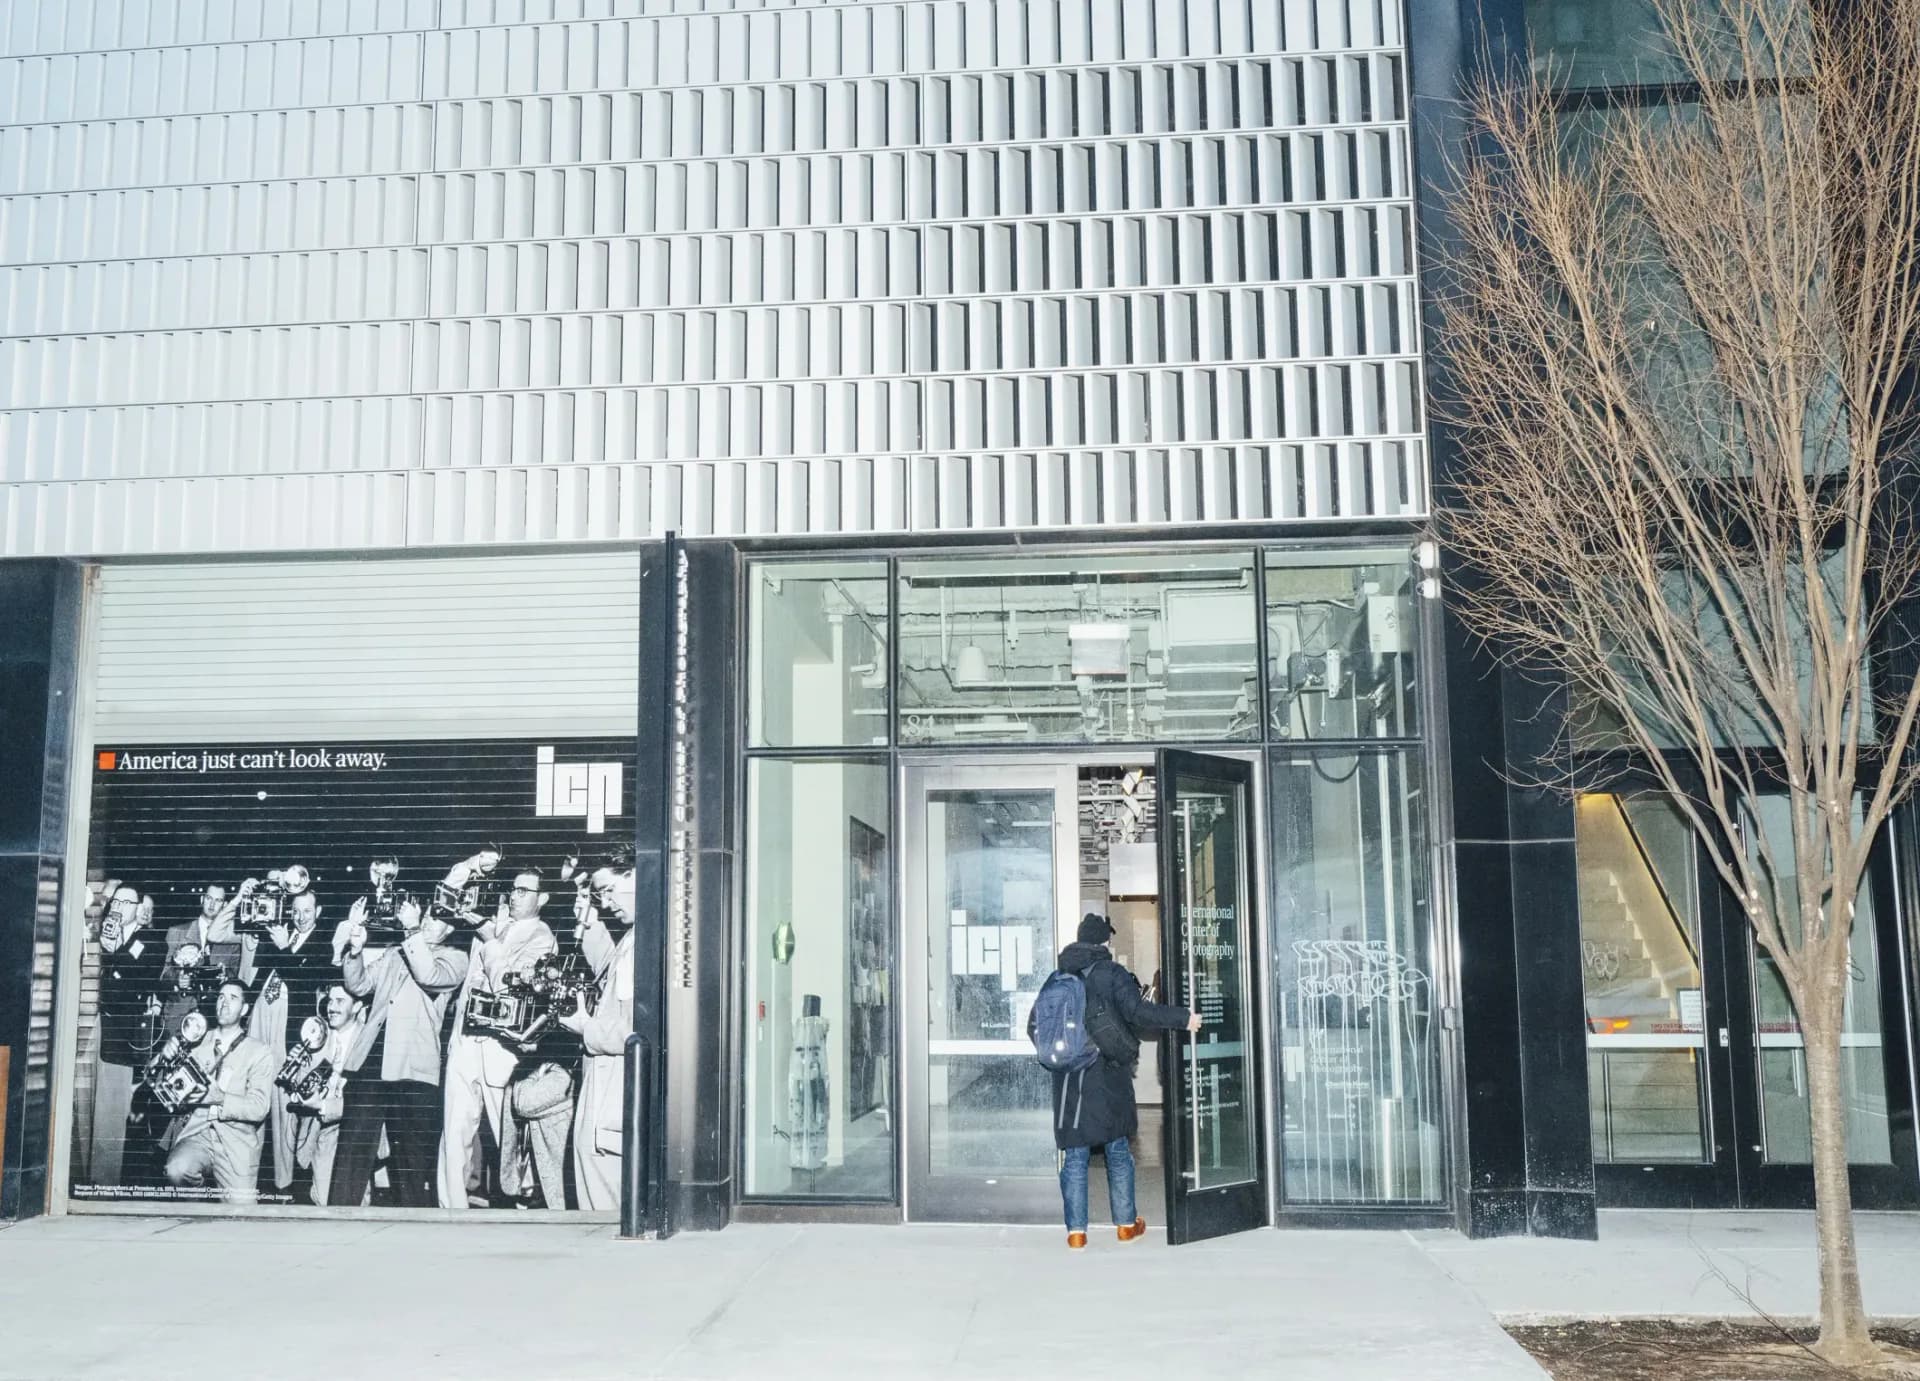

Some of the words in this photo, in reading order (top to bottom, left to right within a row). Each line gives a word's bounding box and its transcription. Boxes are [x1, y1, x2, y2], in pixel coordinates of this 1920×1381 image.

[118, 752, 197, 771] America
[199, 750, 238, 773] just
[240, 750, 287, 769] can’t
[289, 748, 335, 769] look
[336, 752, 389, 773] away.
[536, 746, 623, 833] icp
[1181, 904, 1234, 919] Inernational
[1181, 922, 1209, 937] Cnter
[1211, 922, 1220, 937] of
[951, 910, 1033, 991] icp
[1182, 940, 1235, 960] Potography
